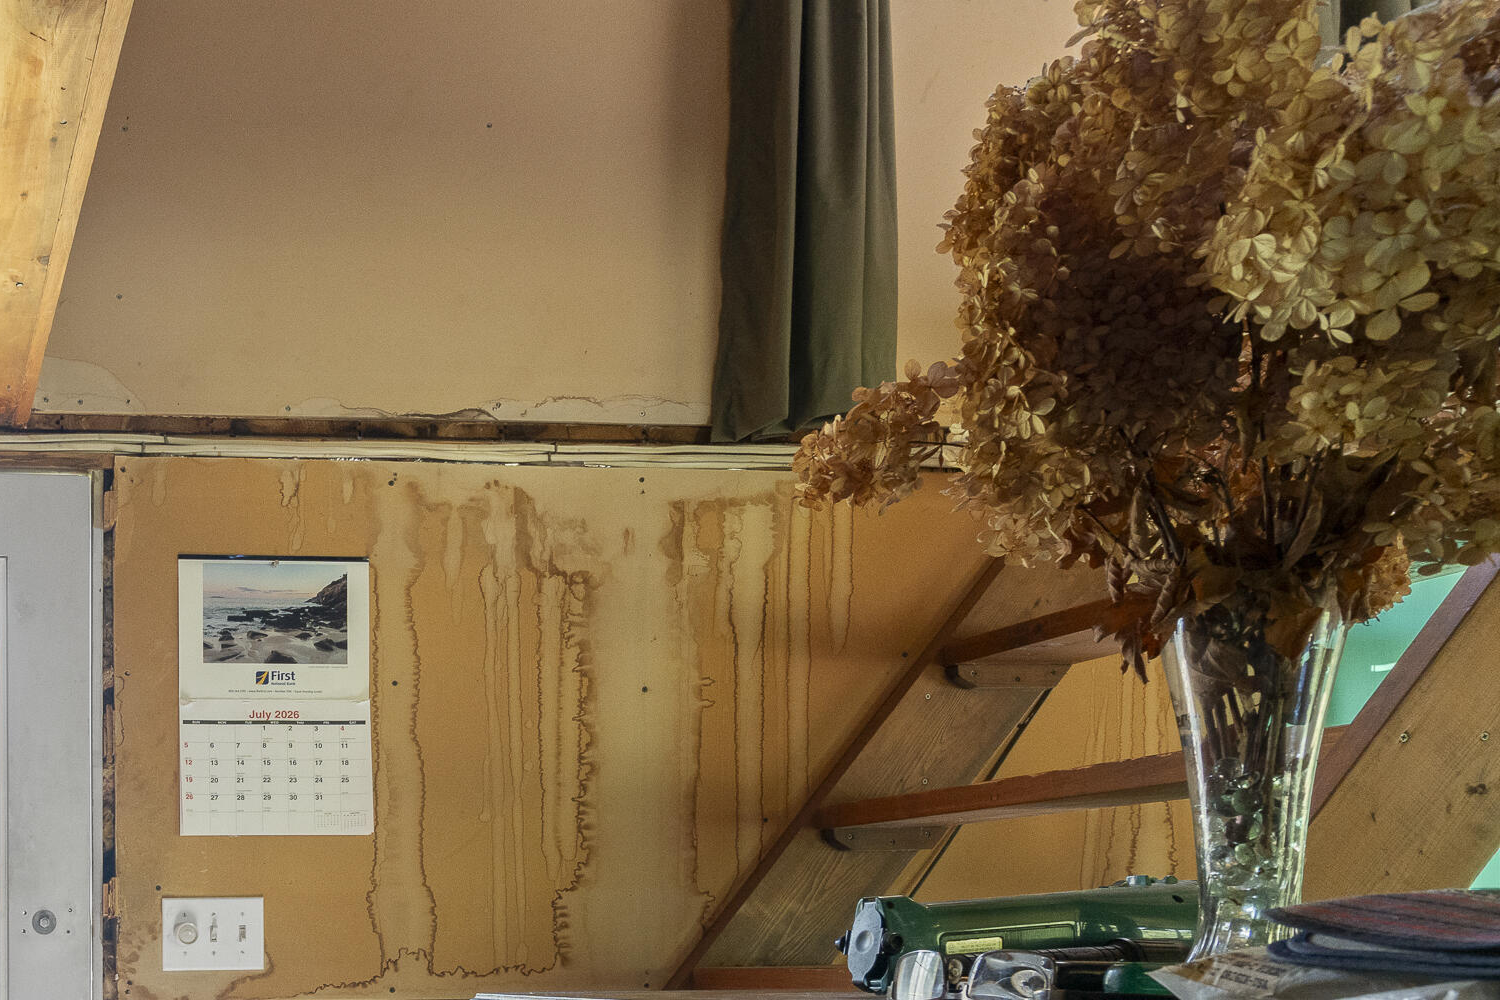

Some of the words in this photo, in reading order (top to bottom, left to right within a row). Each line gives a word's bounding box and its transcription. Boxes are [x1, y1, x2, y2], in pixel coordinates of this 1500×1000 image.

[271, 670, 295, 681] First
[249, 710, 271, 720] July
[274, 710, 300, 719] 2026
